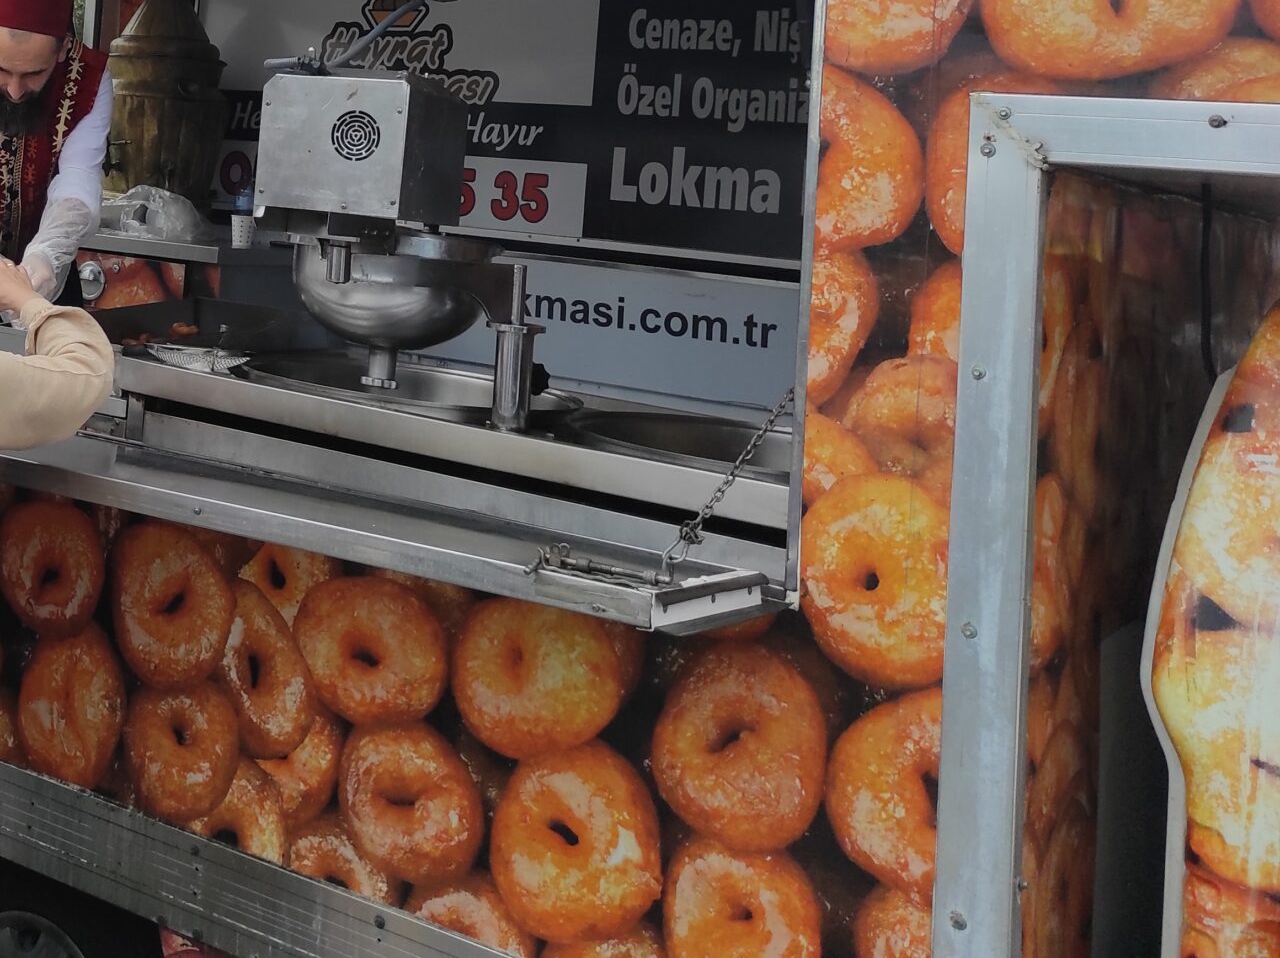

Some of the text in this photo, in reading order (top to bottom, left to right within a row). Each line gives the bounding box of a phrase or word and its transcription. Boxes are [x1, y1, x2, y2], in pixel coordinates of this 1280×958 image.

[629, 8, 742, 57] Cenaze,
[617, 63, 682, 117] Özel
[467, 112, 544, 151] Hayır
[490, 170, 549, 224] 35
[610, 146, 781, 214] Lokma
